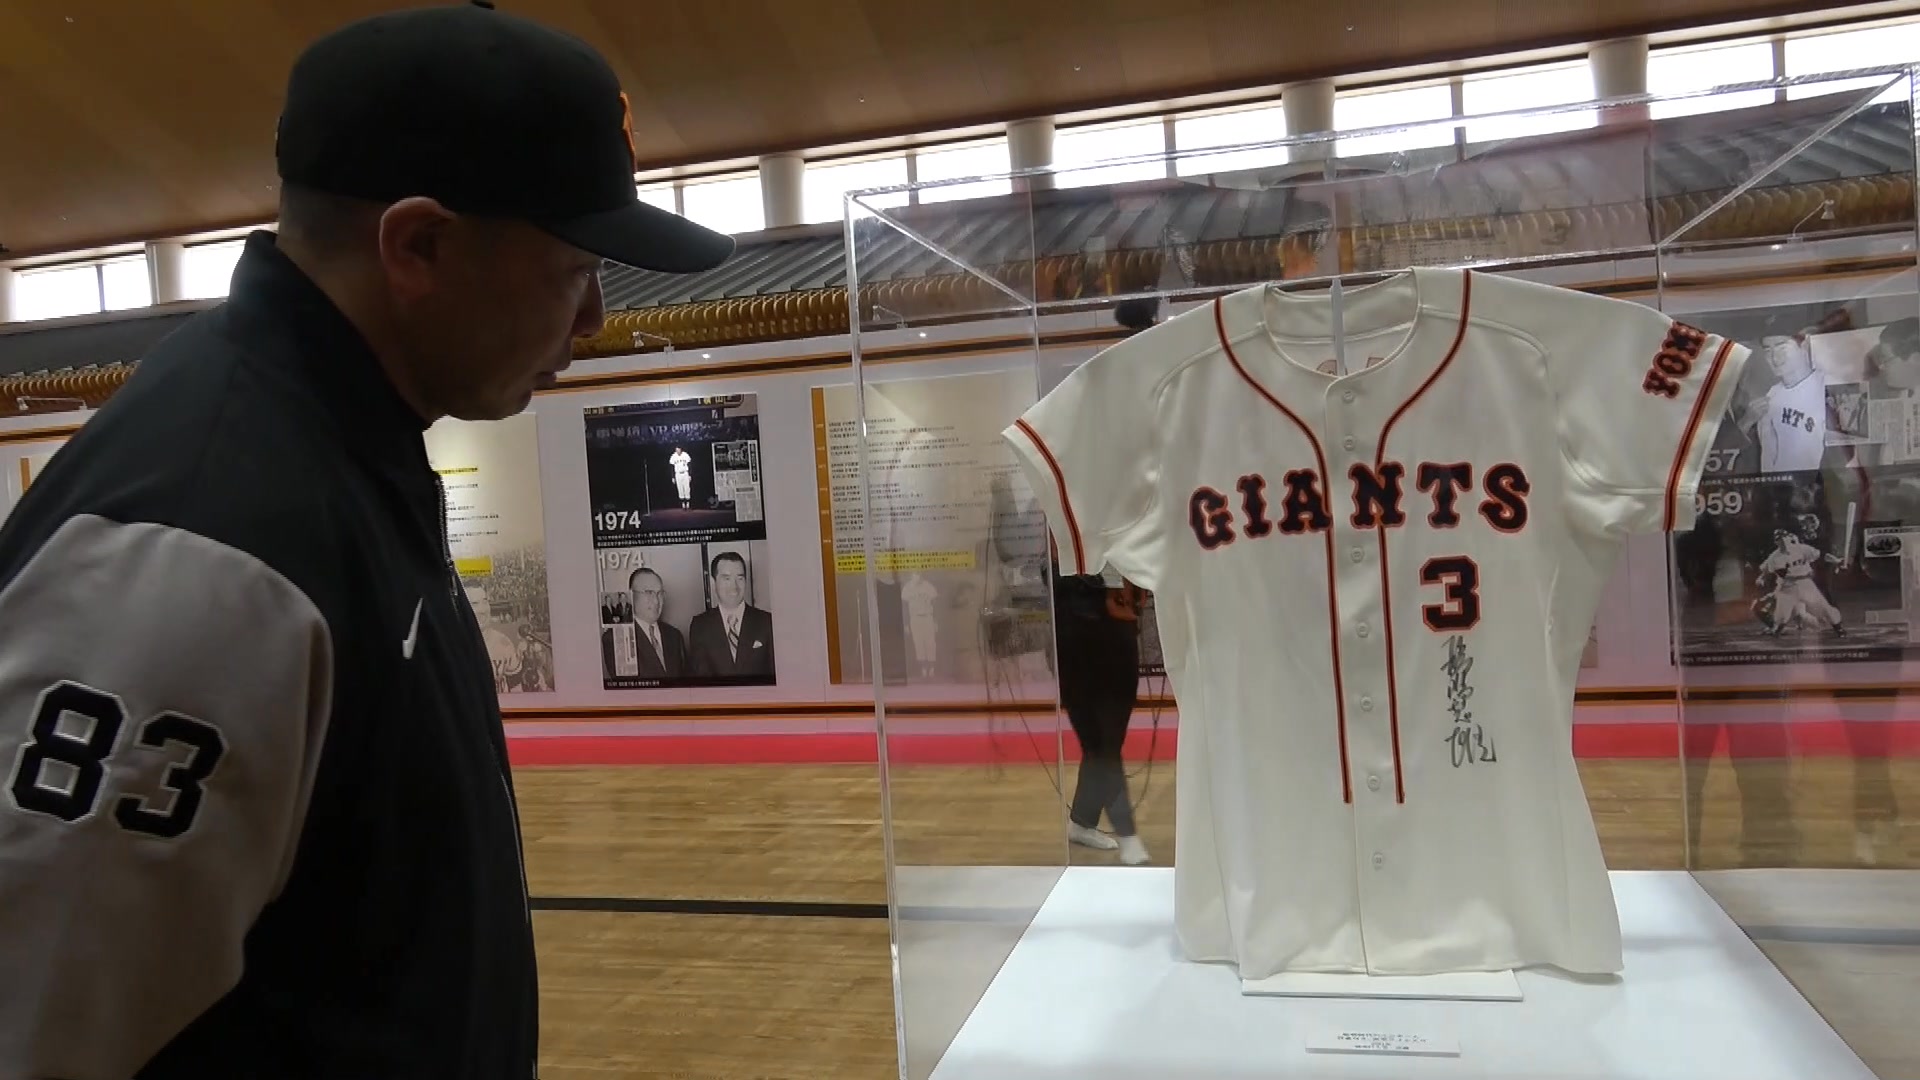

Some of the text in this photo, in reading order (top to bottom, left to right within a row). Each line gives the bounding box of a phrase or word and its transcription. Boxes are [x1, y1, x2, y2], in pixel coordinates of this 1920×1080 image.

[1705, 448, 1740, 472] 57
[1189, 461, 1530, 550] GIANTS
[1695, 491, 1743, 516] 959
[595, 510, 641, 531] 1974
[599, 550, 645, 570] 1974
[1419, 555, 1481, 633] 3
[5, 679, 230, 839] 83
